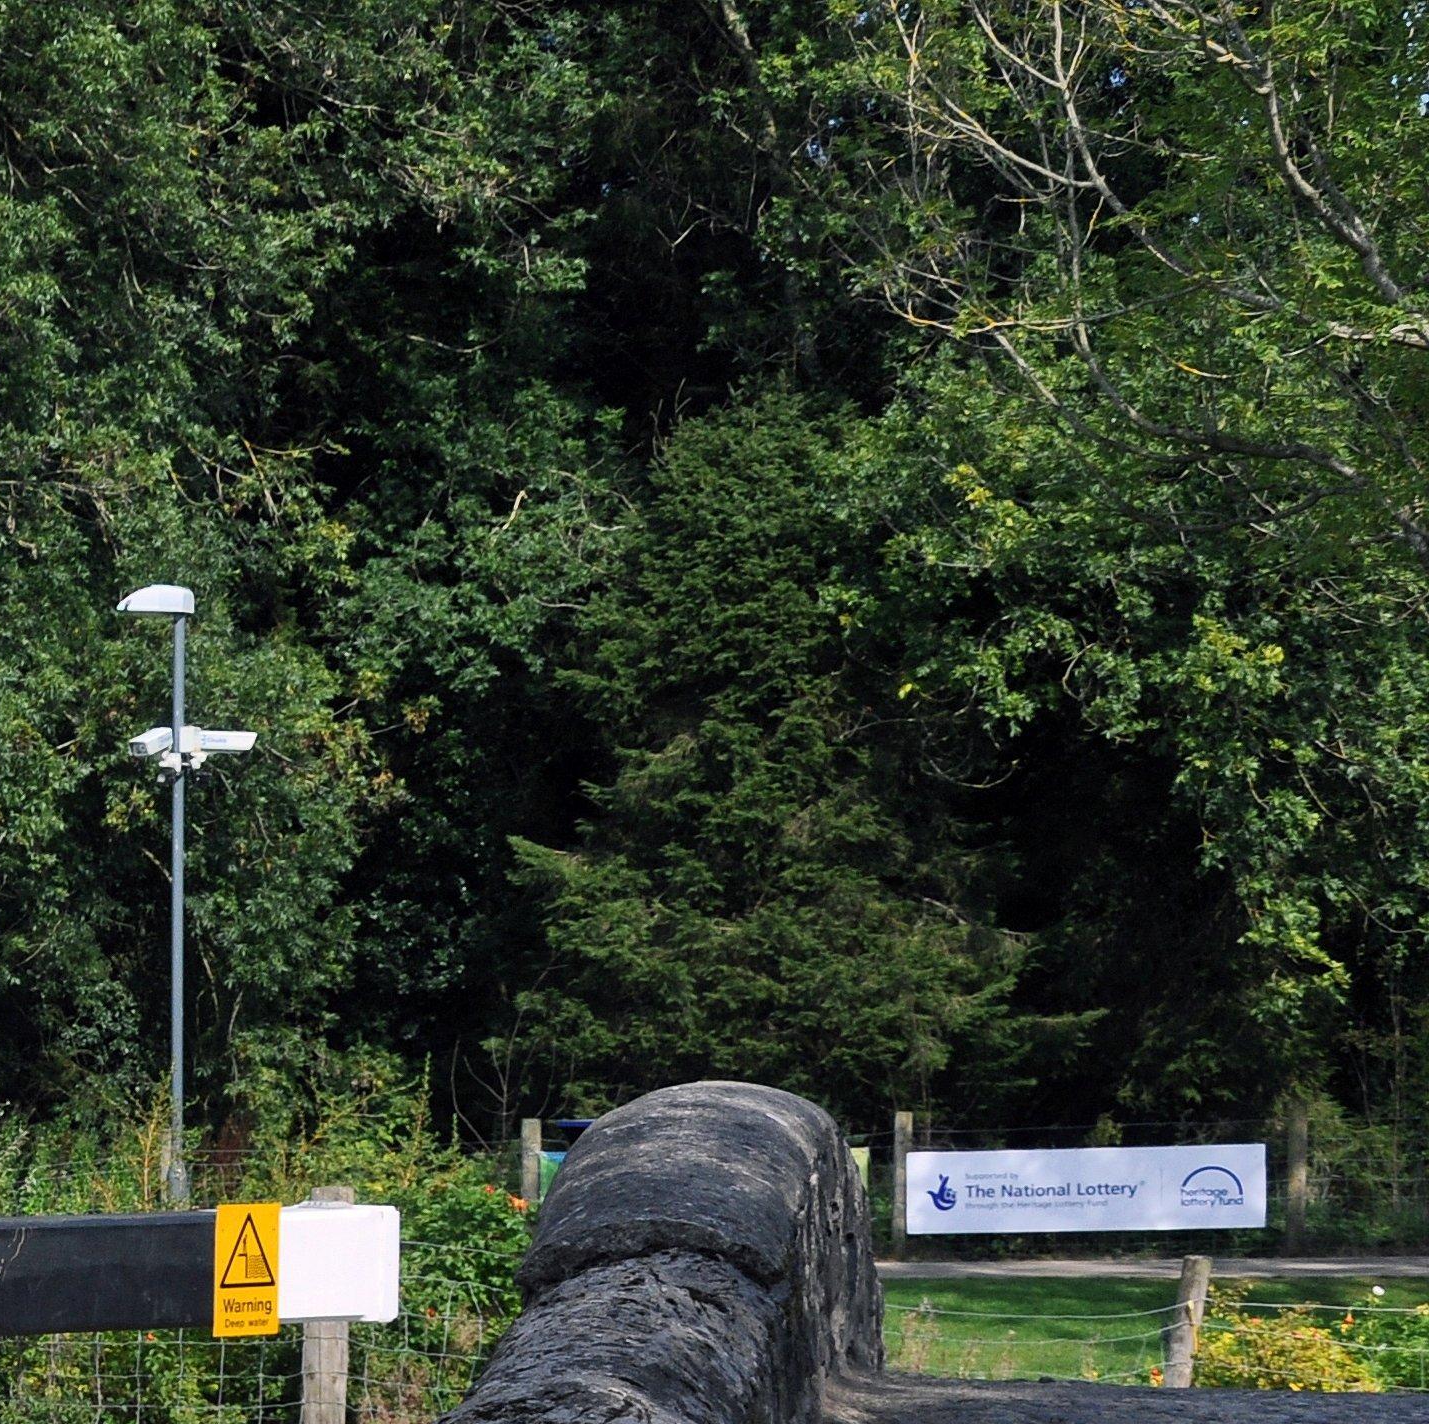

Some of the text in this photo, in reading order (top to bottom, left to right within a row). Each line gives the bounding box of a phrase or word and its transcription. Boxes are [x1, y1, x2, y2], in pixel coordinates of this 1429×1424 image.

[965, 1172, 1008, 1181] Supported
[965, 1182, 1138, 1199] The National Lottery
[1181, 1188, 1228, 1198] heritage
[1017, 1200, 1053, 1210] Heritage
[1087, 1199, 1108, 1207] Fund
[1181, 1196, 1243, 1208] lottery fund
[223, 1297, 273, 1315] Warning
[225, 1317, 270, 1329] Deep water
